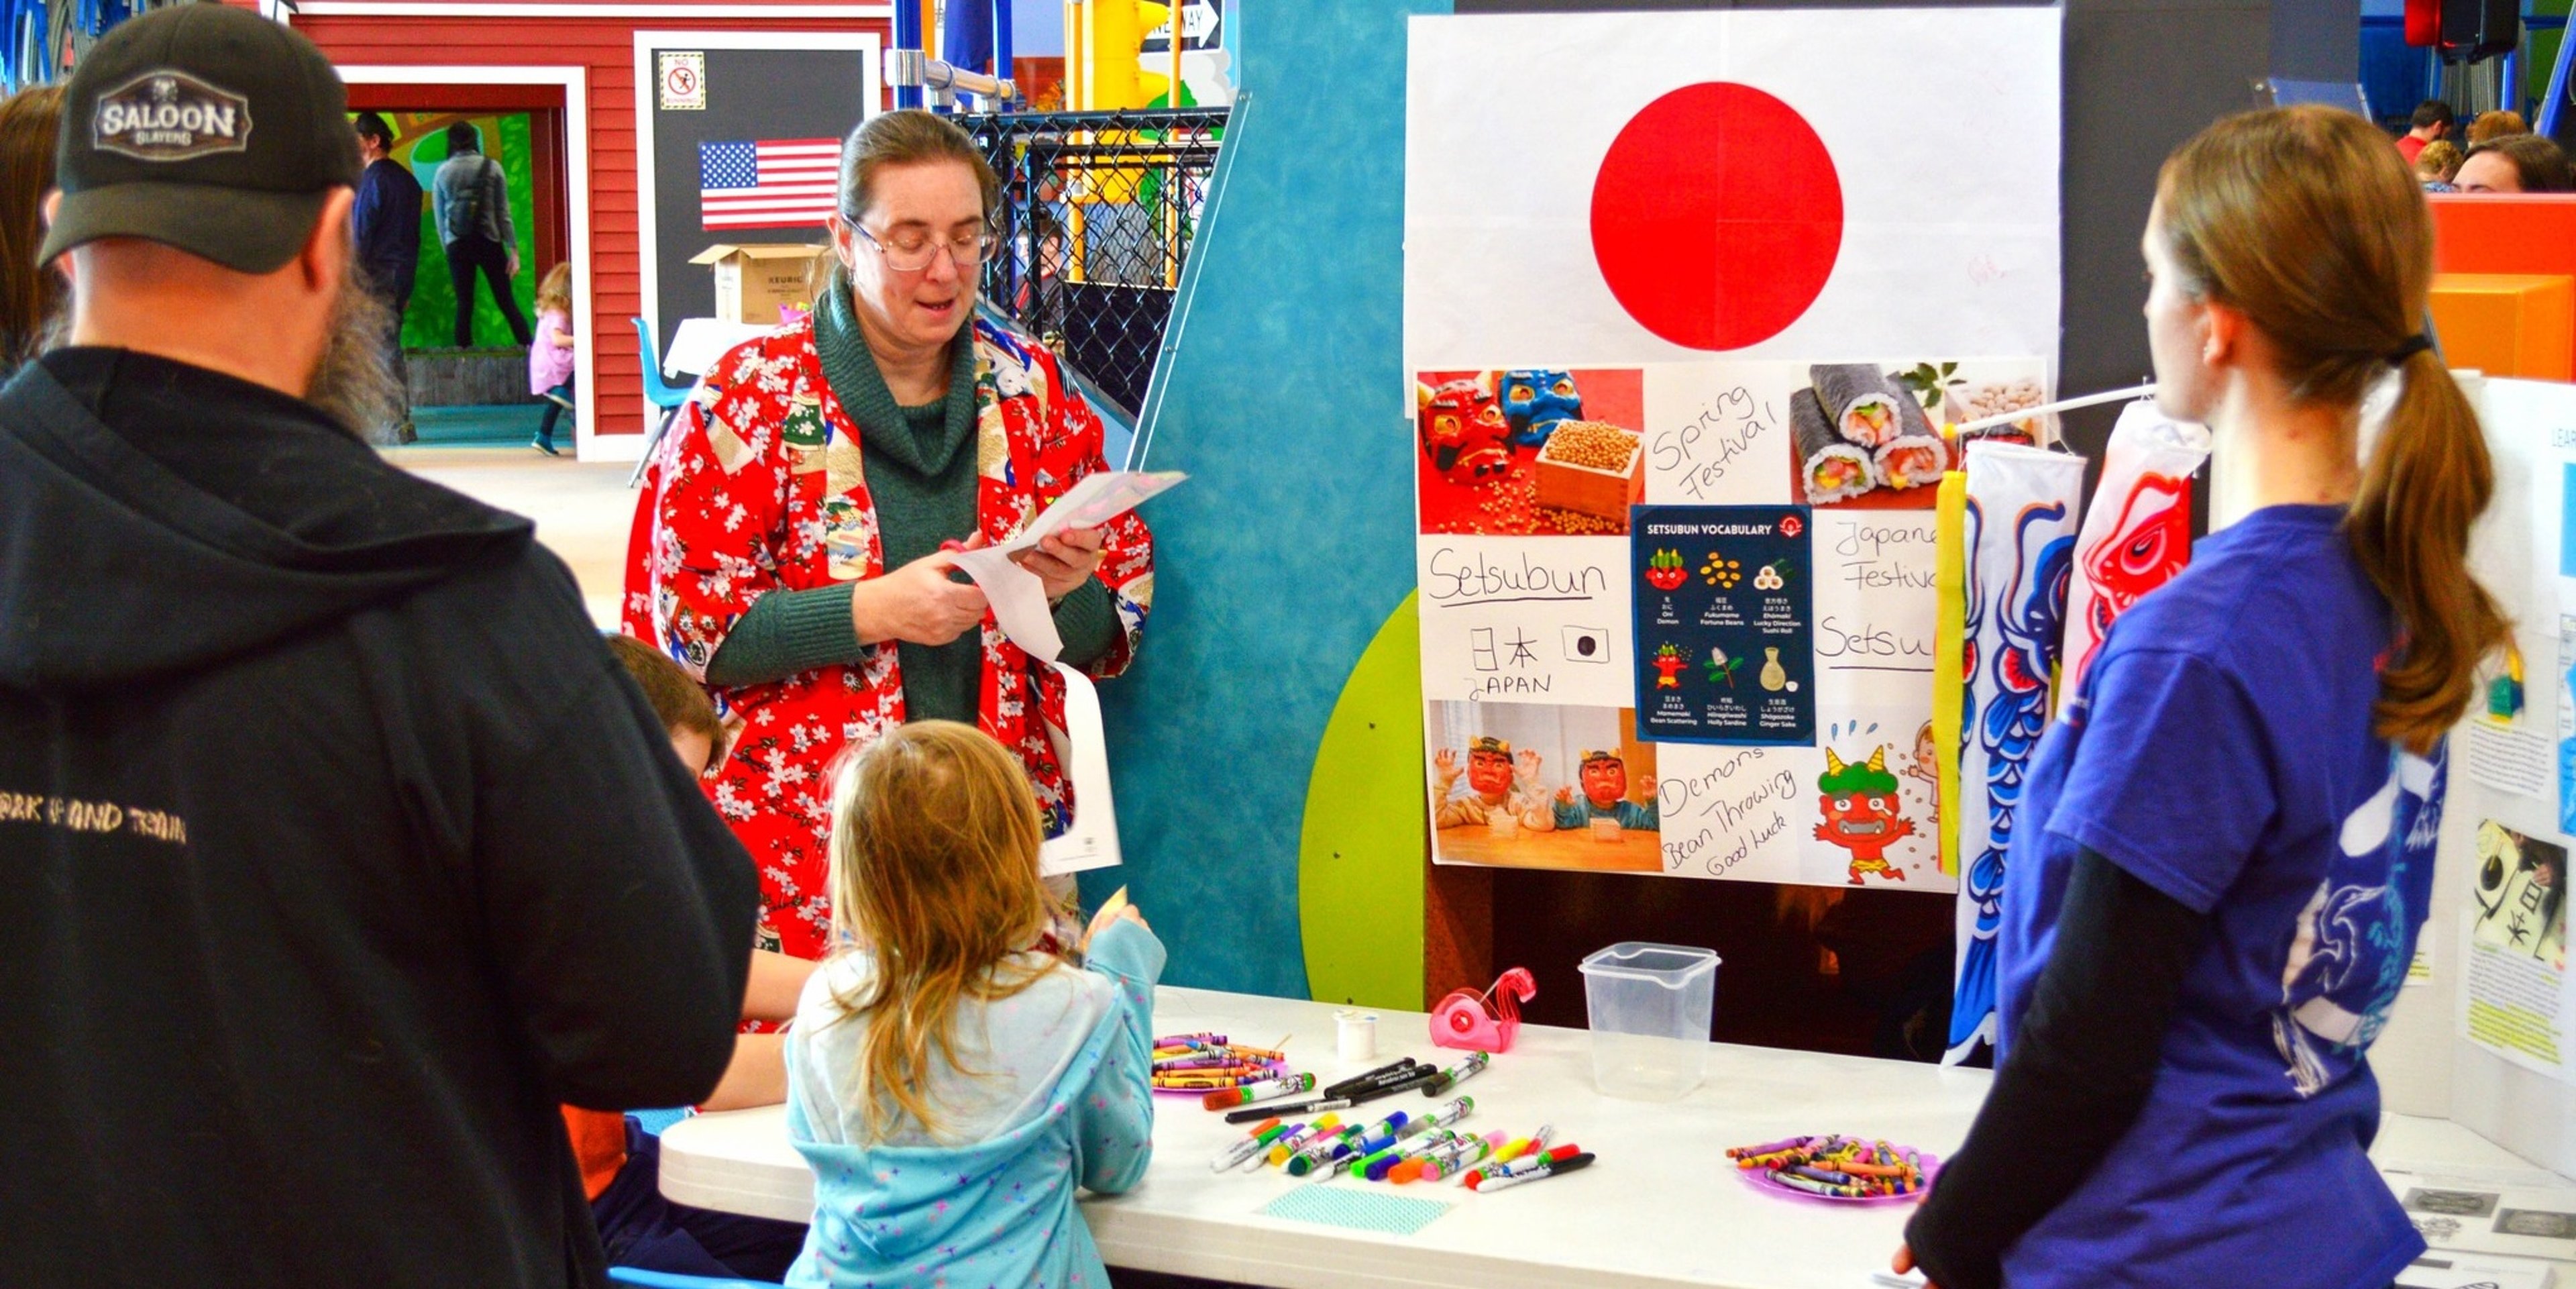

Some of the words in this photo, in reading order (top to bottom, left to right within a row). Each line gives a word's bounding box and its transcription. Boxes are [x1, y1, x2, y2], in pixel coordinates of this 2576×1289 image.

[103, 104, 235, 138] SALOON
[136, 131, 192, 146] SLAYERS
[1654, 386, 1755, 470] Spring
[1679, 401, 1776, 500] Festival
[1647, 524, 1699, 535] SETSUBUN
[1702, 524, 1772, 535] VOCABULARY
[1429, 548, 1606, 599] Setsubun
[1470, 626, 1538, 671] 日本
[1463, 674, 1551, 701] JAPAN
[1668, 717, 1698, 725] Scattering
[1659, 748, 1764, 818] Demons
[68, 798, 123, 833] AND
[1662, 828, 1713, 869] Bean
[1707, 835, 1748, 876] Good
[1750, 811, 1787, 849] Luck
